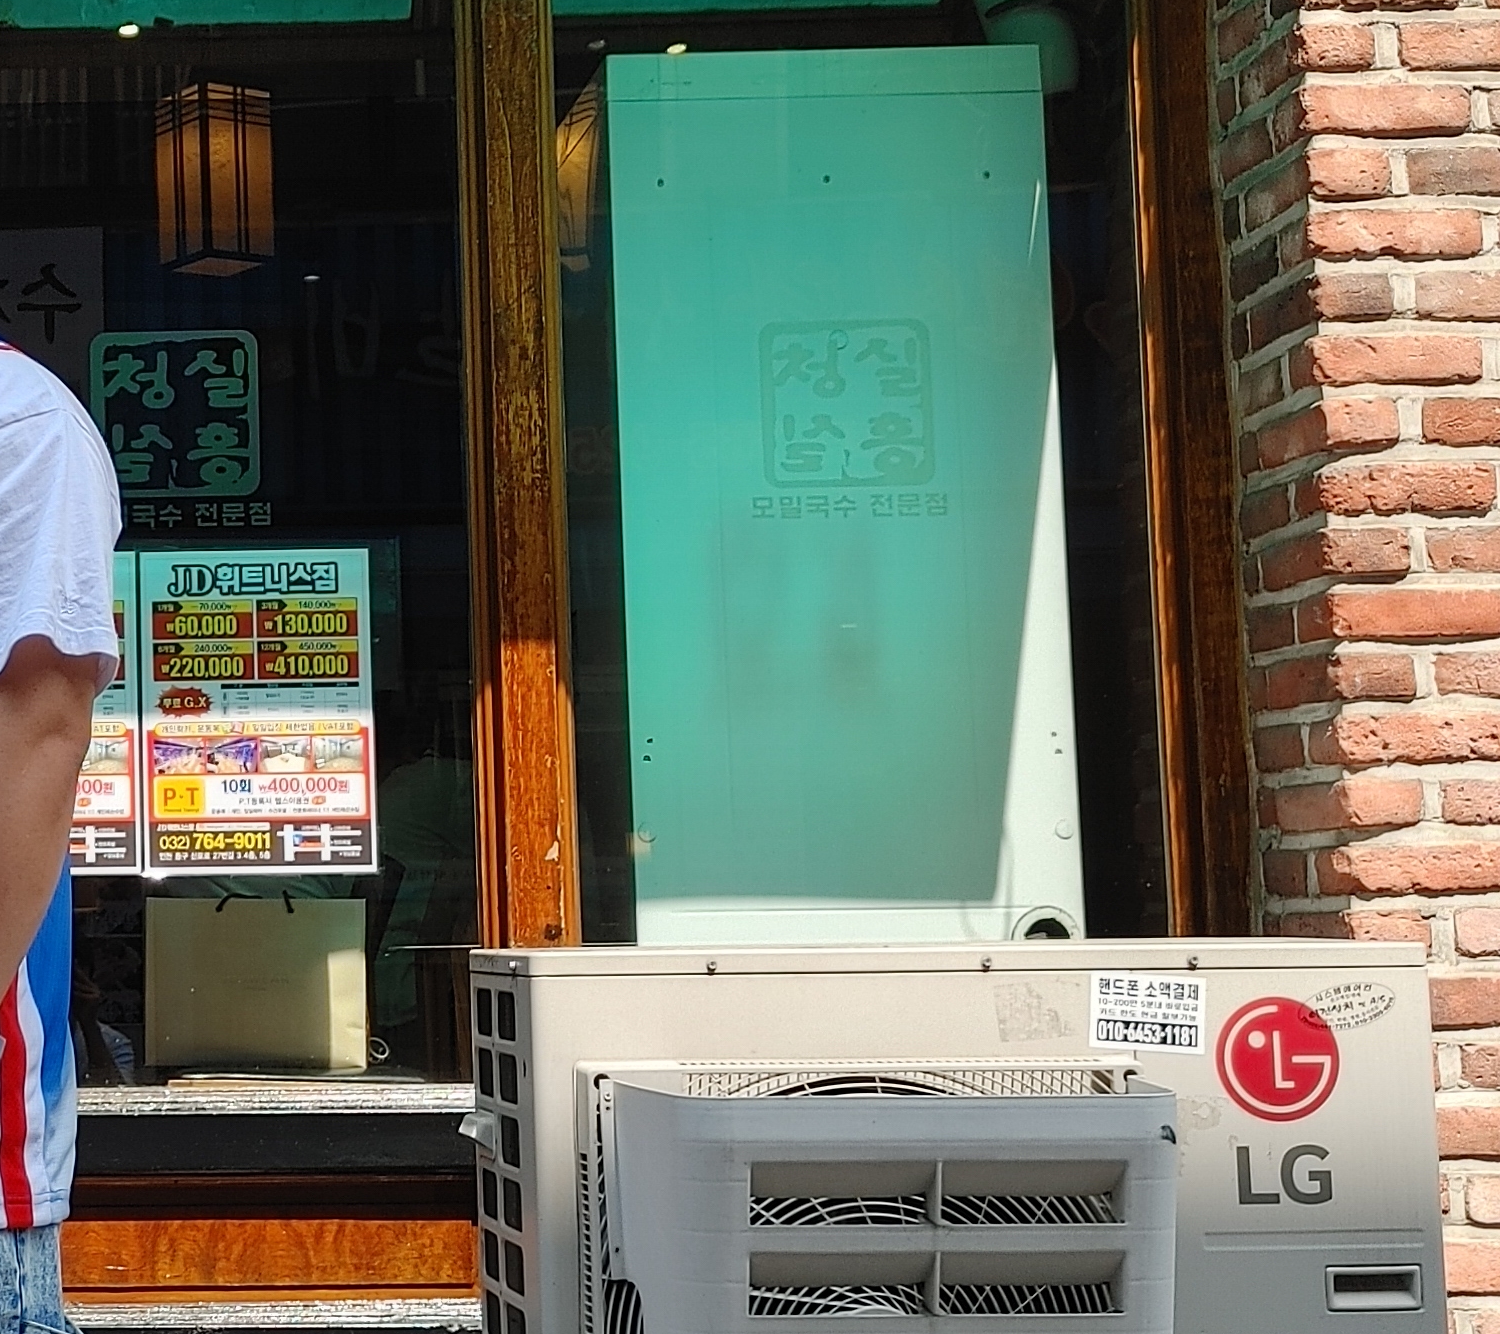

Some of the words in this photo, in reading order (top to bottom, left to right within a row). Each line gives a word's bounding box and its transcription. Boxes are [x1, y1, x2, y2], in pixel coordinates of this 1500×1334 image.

[194, 501, 273, 527] 전문점
[750, 495, 858, 520] 모밀국수
[870, 492, 949, 518] 전문점
[192, 832, 272, 850] 764-9011
[1098, 977, 1140, 998] 핸드폰
[1144, 981, 1199, 1001] 소액결제
[1236, 1144, 1333, 1205] LG
